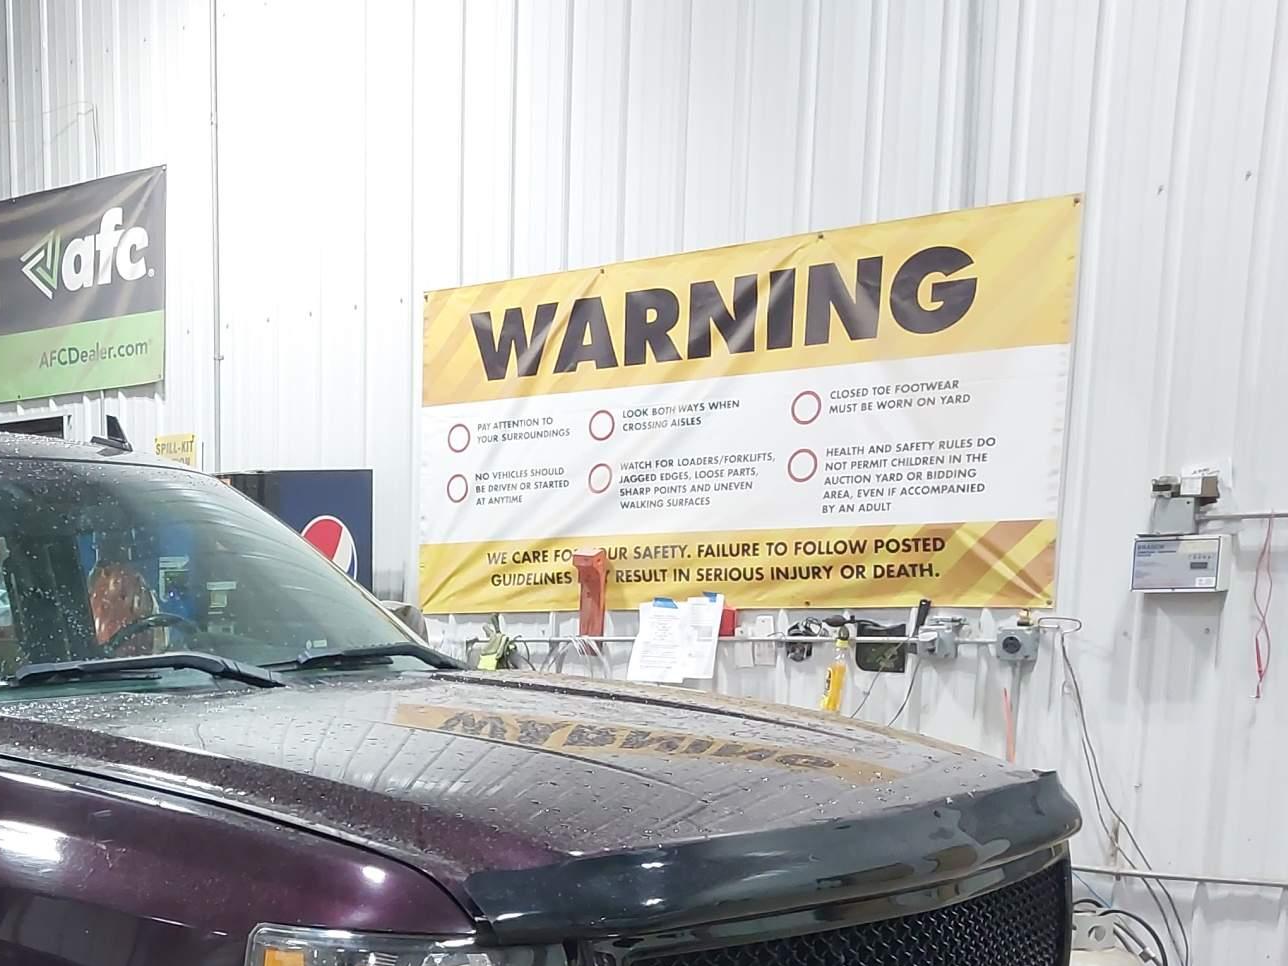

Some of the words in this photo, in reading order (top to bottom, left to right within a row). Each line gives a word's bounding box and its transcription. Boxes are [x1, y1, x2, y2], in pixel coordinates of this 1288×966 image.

[62, 207, 149, 291] afc
[470, 245, 978, 382] WARNING
[39, 342, 148, 369] AFCDealer.com
[830, 388, 869, 400] CLOSED
[872, 385, 891, 396] TOE
[894, 380, 959, 394] FOOTWEAR
[622, 408, 649, 419] LOOK
[652, 405, 676, 416] BOTH
[678, 402, 705, 414] WAYS
[708, 400, 740, 411] WHEN
[829, 403, 857, 415] MUST
[860, 402, 873, 412] BE
[876, 398, 912, 410] WORN
[916, 397, 936, 407] ON
[940, 394, 971, 405] YARD
[477, 423, 491, 431] PAY
[493, 419, 539, 430] ATTENTION
[542, 416, 553, 425] TO
[622, 419, 668, 432] CROSSING
[670, 416, 702, 427] AISLES
[477, 434, 498, 444] YOUR
[501, 428, 570, 441] SURROUNDINGS
[155, 440, 193, 456] SPILL-KIT
[826, 446, 864, 457] HEALTH
[868, 444, 892, 455] AND
[895, 441, 935, 453] SAFETY
[938, 438, 973, 450] RULES
[977, 437, 996, 447] DO
[620, 460, 652, 471] WATCH
[655, 459, 674, 469] FOR
[677, 452, 776, 467] LOADERS/FORKLIFTS,
[825, 461, 847, 471] NOT
[850, 459, 888, 470] PERMIT
[890, 455, 944, 468] CHILDREN
[948, 454, 962, 464] IN
[966, 452, 988, 463] THE
[475, 472, 490, 481] NO
[492, 469, 528, 480] VEHICLES
[530, 467, 564, 477] SHOULD
[619, 473, 656, 484] JAGGED
[660, 471, 691, 482] EDGES,
[694, 469, 724, 480] LOOSE
[727, 467, 759, 478] PARTS,
[824, 474, 872, 486] AUCTION
[875, 471, 903, 483] YARD
[906, 471, 923, 481] OR
[926, 468, 977, 480] BIDDING
[475, 485, 485, 494] BE
[488, 482, 517, 492] DRIVEN
[520, 481, 531, 490] OR
[533, 479, 569, 489] STARTED
[620, 487, 651, 497] SHARP
[653, 485, 687, 495] POINTS
[690, 483, 711, 493] AND
[713, 481, 753, 491] UNEVEN
[823, 489, 853, 500] AREA,
[857, 488, 884, 498] EVEN
[887, 487, 897, 497] IF
[900, 483, 985, 496] ACCOMPANIED
[476, 497, 486, 506] AT
[488, 495, 522, 505] ANYTIME
[620, 499, 664, 510] WALKING
[666, 497, 710, 508] SURFACES
[822, 504, 835, 514] BY
[838, 503, 855, 513] AN
[858, 502, 892, 512] ADULT
[487, 551, 507, 565] WE
[512, 549, 549, 564] CARE
[554, 549, 578, 562] FO
[633, 545, 691, 559] SAFETY.
[697, 542, 760, 558] FAILURE
[766, 541, 788, 556] TO
[794, 539, 867, 555] FOLLOW
[874, 537, 945, 554] POSTED
[491, 572, 572, 587] GUIDELINES
[615, 569, 668, 583] RESULT
[673, 568, 690, 582] IN
[696, 567, 764, 581] SERIOUS
[771, 566, 833, 580] INJURY
[840, 564, 866, 579] OR
[873, 563, 940, 579] DEATH.
